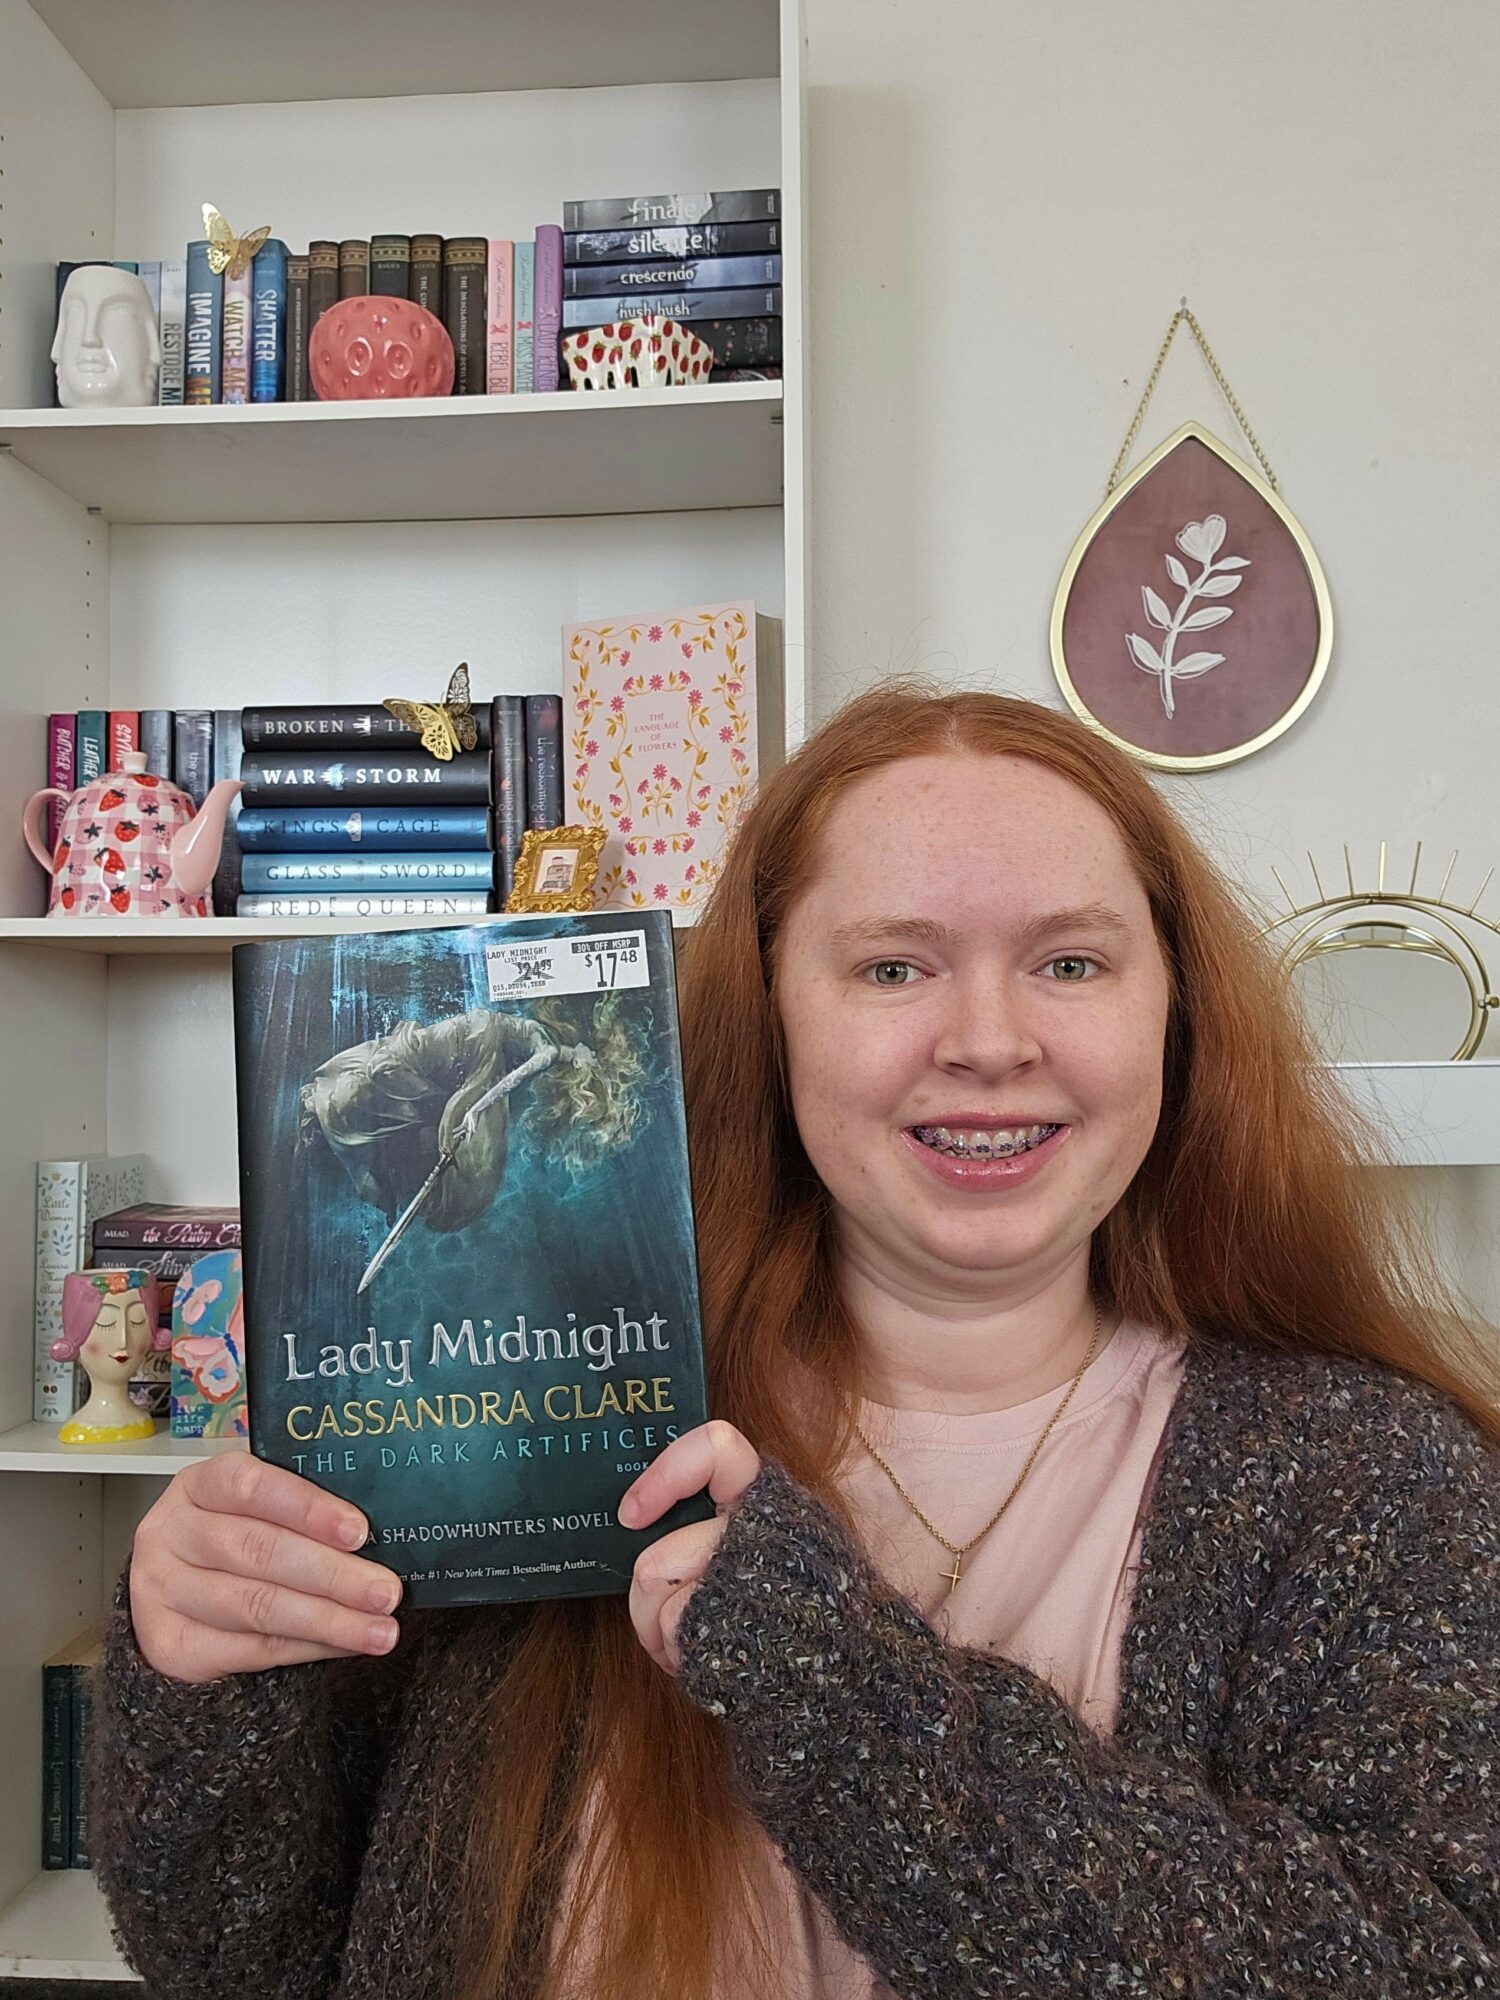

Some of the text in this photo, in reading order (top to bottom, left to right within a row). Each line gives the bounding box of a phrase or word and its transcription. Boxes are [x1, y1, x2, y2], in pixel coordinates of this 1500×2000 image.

[627, 196, 697, 225] finale
[420, 276, 428, 290] THE
[460, 275, 468, 289] THE
[620, 263, 694, 284] crescendo
[460, 291, 468, 343] DESOLATIONS
[619, 297, 691, 318] hush hush
[188, 292, 212, 374] IMAGINE
[223, 301, 245, 358] WATCH
[255, 289, 277, 361] SHATTER
[537, 323, 558, 351] LADY
[162, 323, 182, 384] RESTORE
[460, 344, 467, 354] OF
[489, 342, 508, 371] REBEL
[517, 336, 533, 358] MISS
[649, 713, 665, 721] THE
[265, 719, 344, 735] BROKEN
[634, 721, 680, 733] LANGUAGE
[504, 737, 520, 755] the
[650, 733, 661, 741] OF
[56, 728, 73, 771] BUTCHER
[638, 742, 677, 752] FLOWERS
[82, 736, 99, 778] LEATHER
[189, 752, 200, 769] the
[261, 768, 442, 785] WAR STORM
[499, 758, 520, 811] becoming
[532, 737, 554, 825] the reckoning of
[263, 819, 441, 834] KING'S CAGE
[266, 863, 467, 880] GLASS SWORD
[271, 900, 322, 917] RED
[357, 898, 458, 917] QUEEN
[487, 946, 548, 960] LADY MIDNIGHT
[576, 940, 632, 952] 30% OFF MSRP
[504, 955, 538, 964] LIST PRICE
[42, 1196, 70, 1209] Little
[39, 1209, 74, 1222] Women
[104, 1230, 130, 1238] MEAD
[142, 1226, 161, 1243] the
[164, 1223, 212, 1248] Ruby
[282, 1307, 671, 1388] Lady Midnight
[176, 1413, 205, 1423] life
[286, 1376, 676, 1441] CASSANDRA CLARE
[175, 1424, 210, 1434] happy
[292, 1425, 679, 1476] THE DARK ARTIFICES
[616, 1461, 649, 1474] BOOK
[366, 1512, 614, 1545] A SHADOWHUNTERS NOVEL
[410, 1571, 426, 1581] the
[428, 1570, 441, 1581] #1
[444, 1569, 464, 1579] New
[465, 1567, 484, 1579] York
[485, 1566, 511, 1577] Times
[512, 1562, 562, 1576] Bestselling
[563, 1558, 597, 1571] Author
